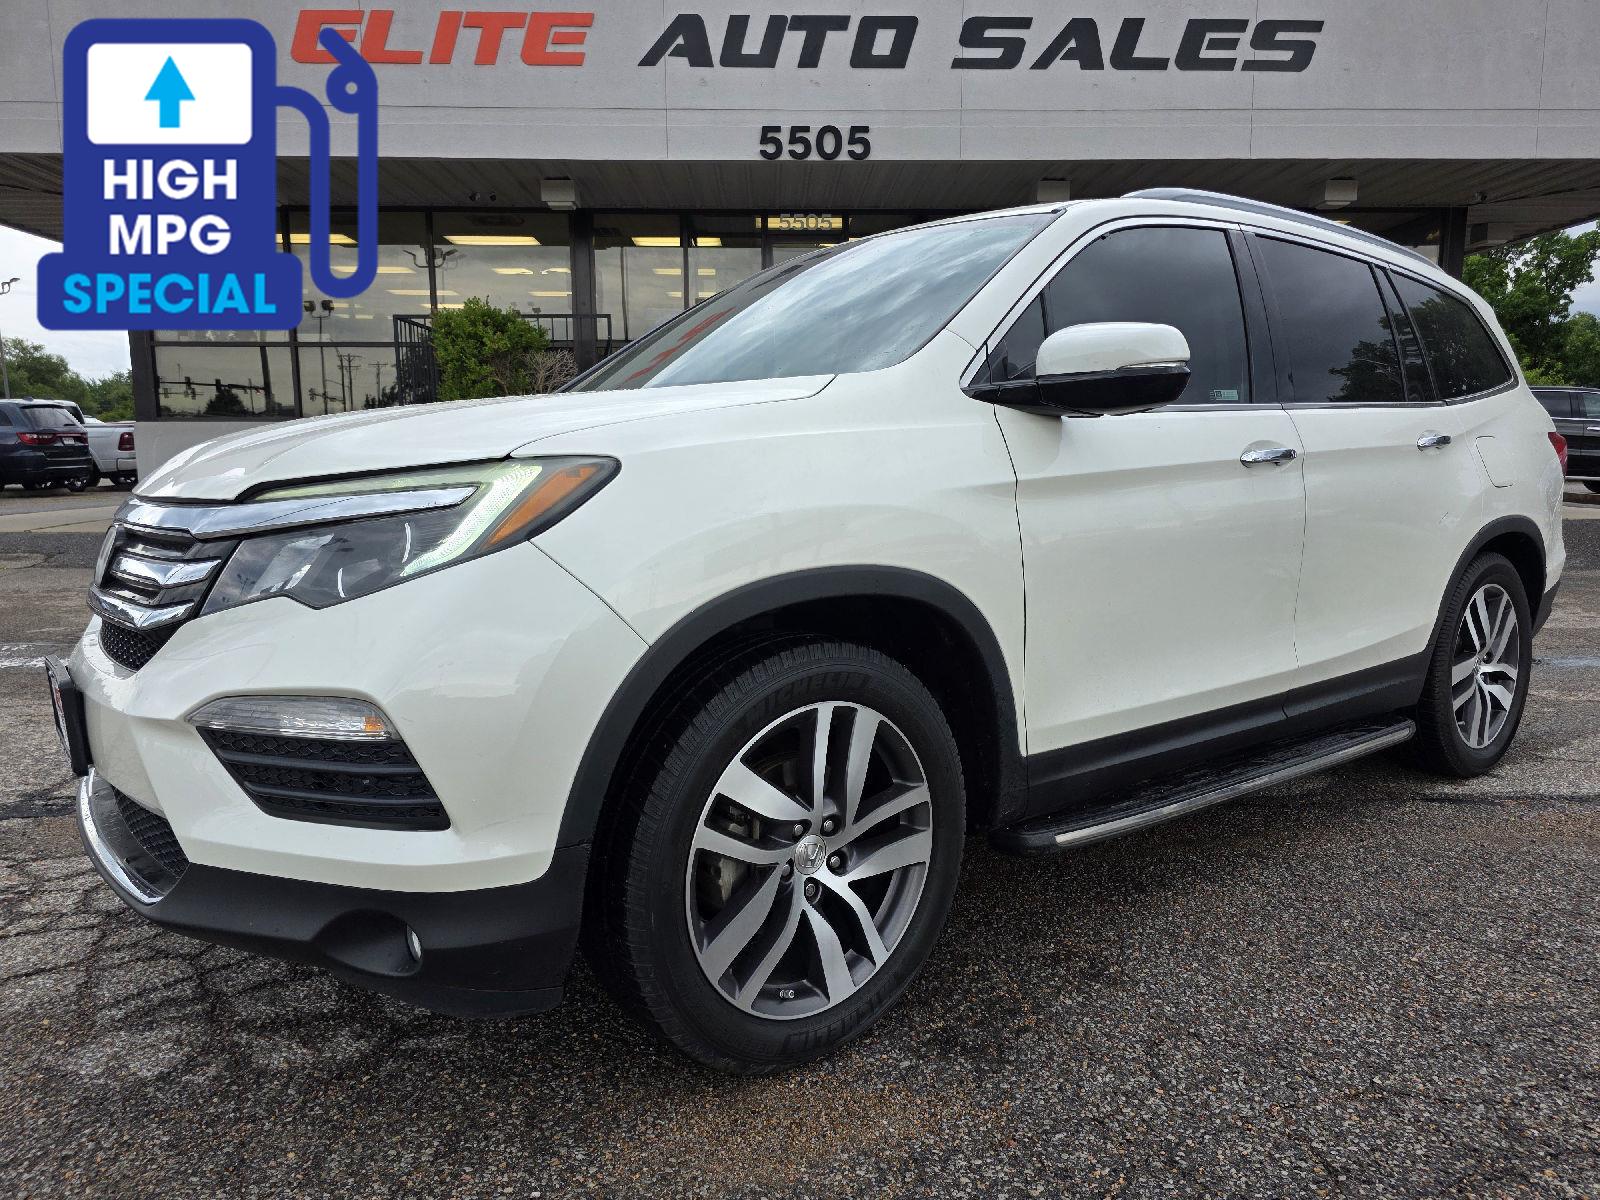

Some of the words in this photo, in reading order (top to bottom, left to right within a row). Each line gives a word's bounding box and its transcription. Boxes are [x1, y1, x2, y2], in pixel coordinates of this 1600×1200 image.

[290, 9, 595, 66] ELITE
[638, 13, 919, 69] AUTO
[951, 16, 1325, 72] SALES
[759, 125, 871, 160] 5505
[779, 213, 833, 231] 5505
